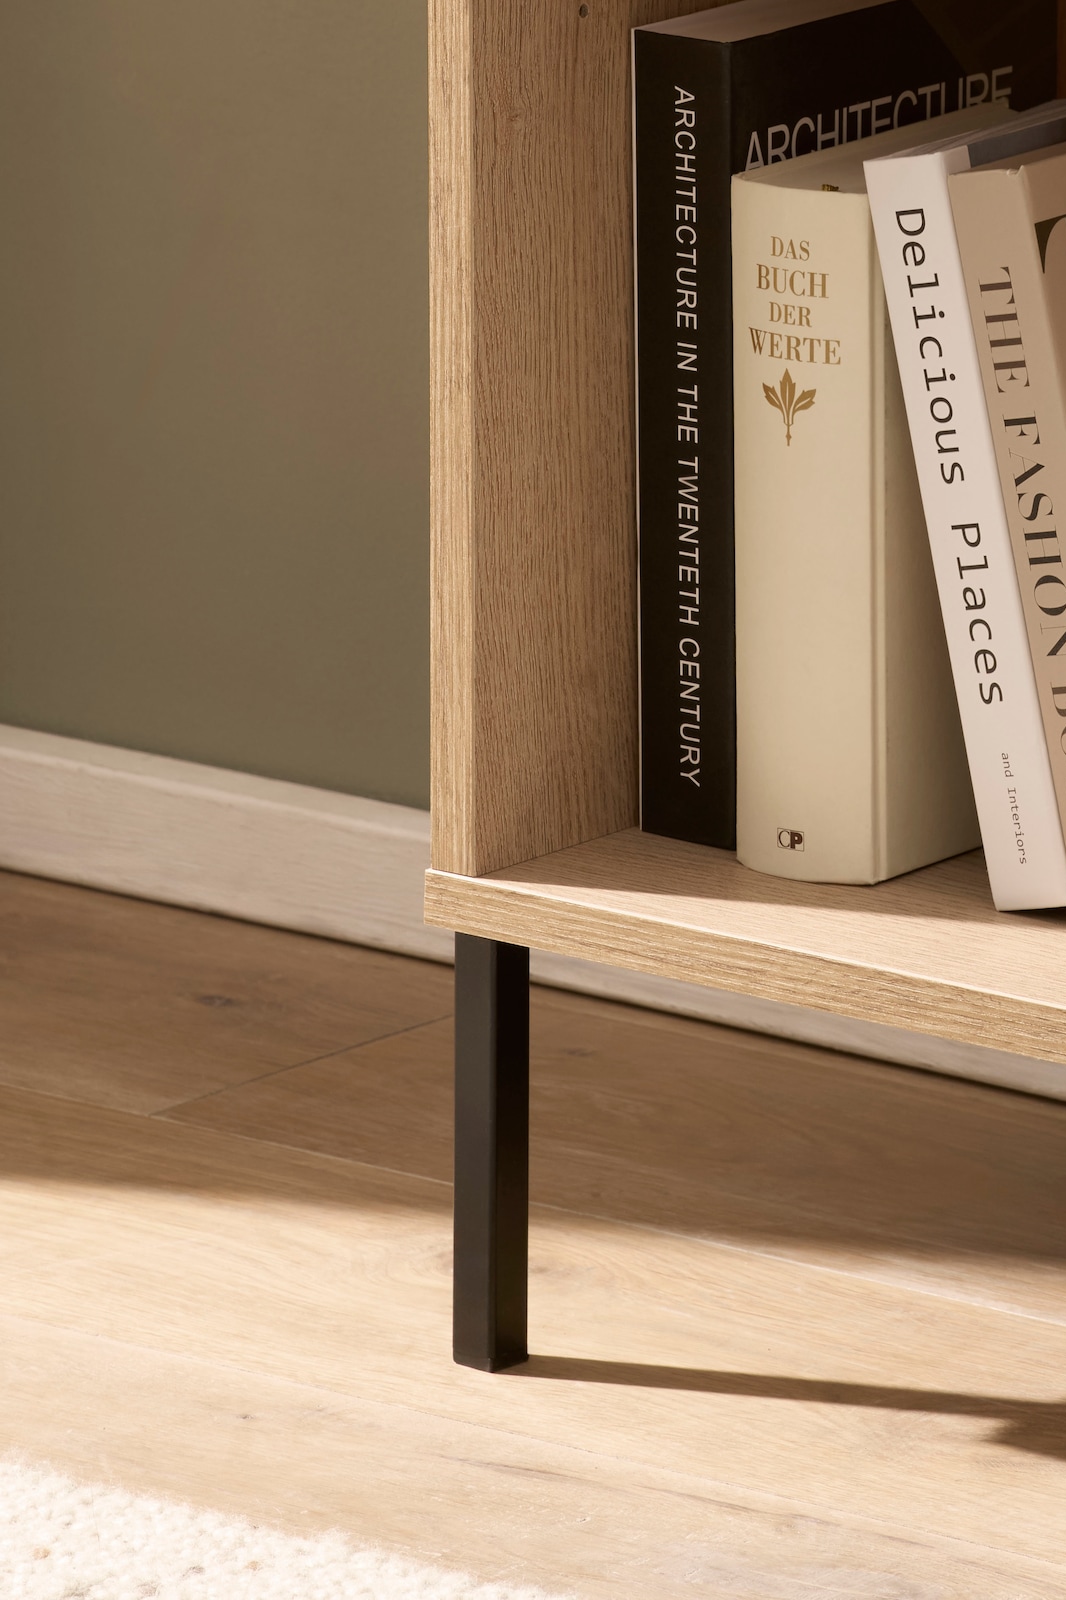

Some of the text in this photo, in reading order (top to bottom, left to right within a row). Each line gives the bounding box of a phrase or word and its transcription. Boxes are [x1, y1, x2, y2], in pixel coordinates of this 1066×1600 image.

[744, 65, 1013, 172] ARCHITECTURE
[755, 263, 830, 300] BUCH
[770, 235, 811, 262] DAS
[748, 326, 842, 366] WERTE
[768, 300, 813, 329] DER
[979, 266, 1031, 394] THE
[673, 85, 701, 788] ARCHITECTURE IN THE TWENTETH CENTURY
[895, 208, 1004, 706] Delicious Places
[777, 829, 804, 850] CP
[1001, 752, 1028, 865] and Interiors
